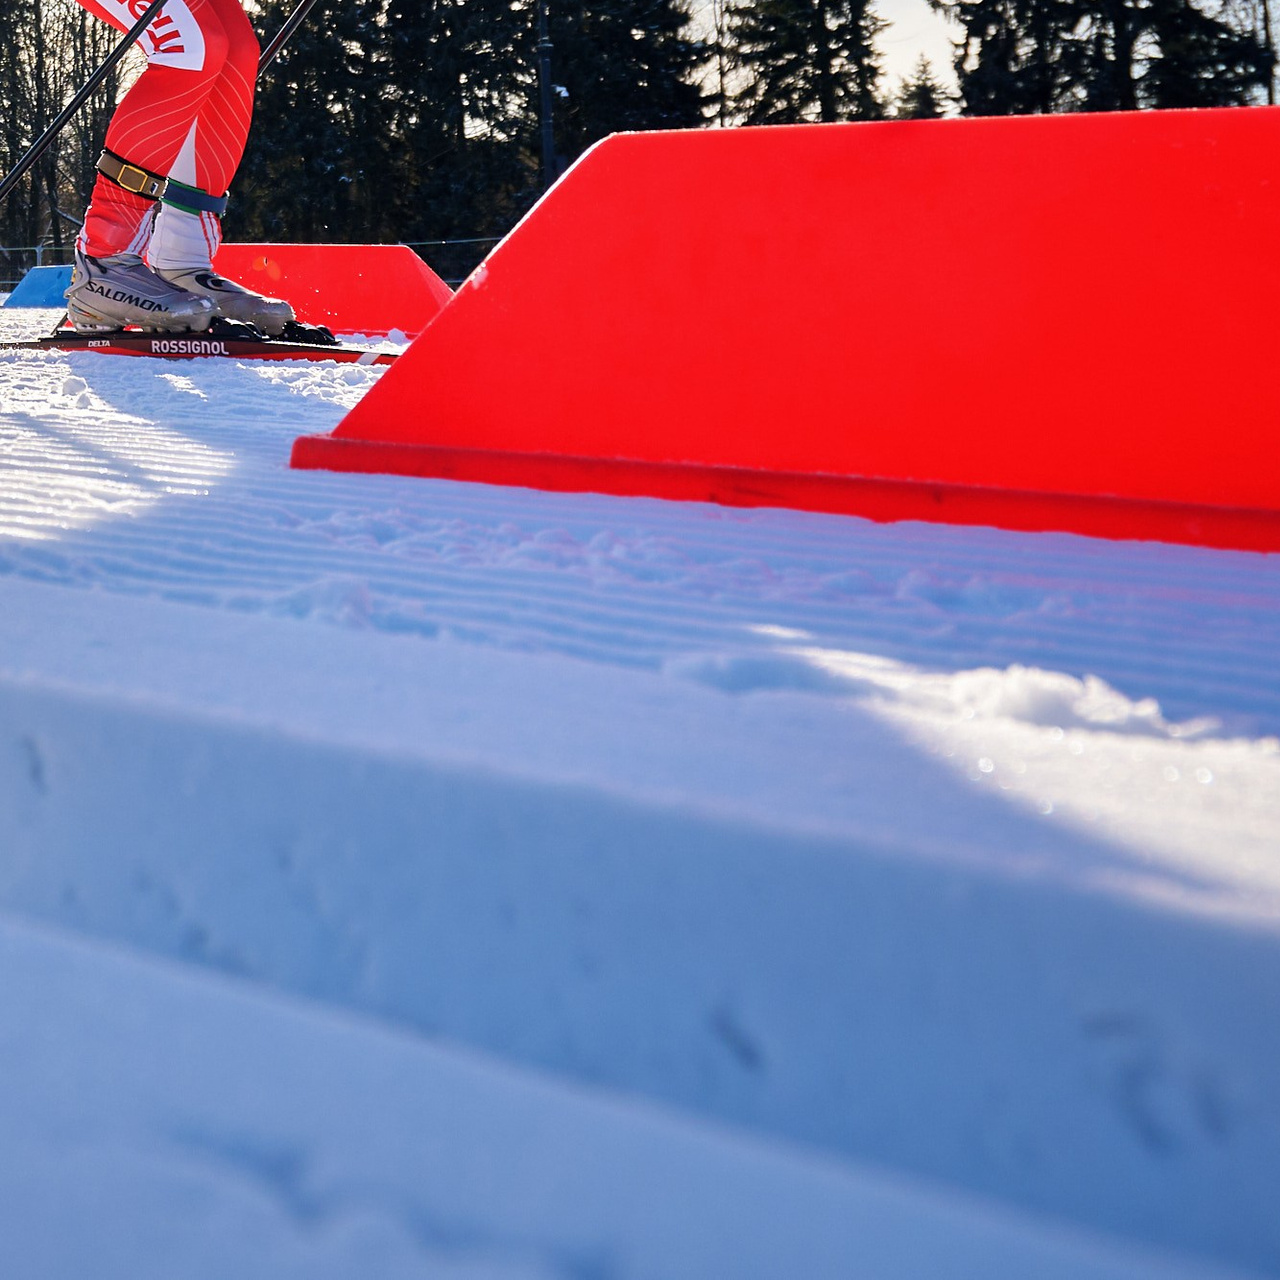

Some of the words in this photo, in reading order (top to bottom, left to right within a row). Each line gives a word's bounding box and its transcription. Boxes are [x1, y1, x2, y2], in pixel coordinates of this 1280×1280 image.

[85, 280, 170, 312] SALOMON
[87, 340, 111, 348] DELTA
[151, 340, 230, 355] ROSSIGNOL
